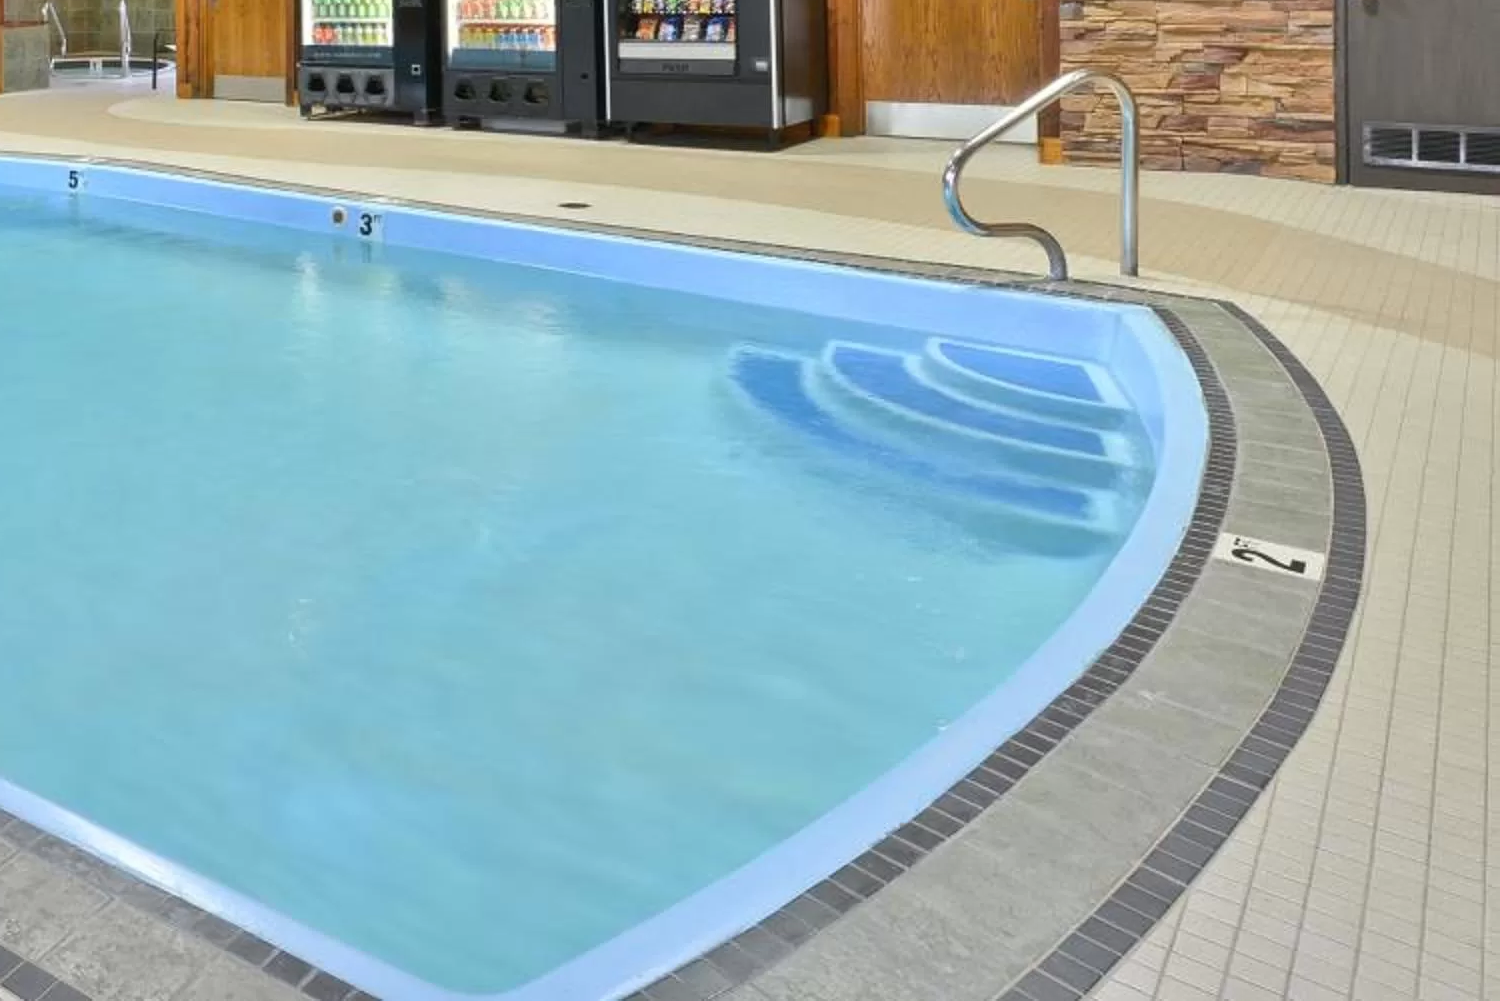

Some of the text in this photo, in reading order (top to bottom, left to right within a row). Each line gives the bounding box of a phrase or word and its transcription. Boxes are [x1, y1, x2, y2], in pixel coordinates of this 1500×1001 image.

[68, 170, 78, 189] 5
[359, 213, 373, 236] 3
[1231, 548, 1306, 574] 2
